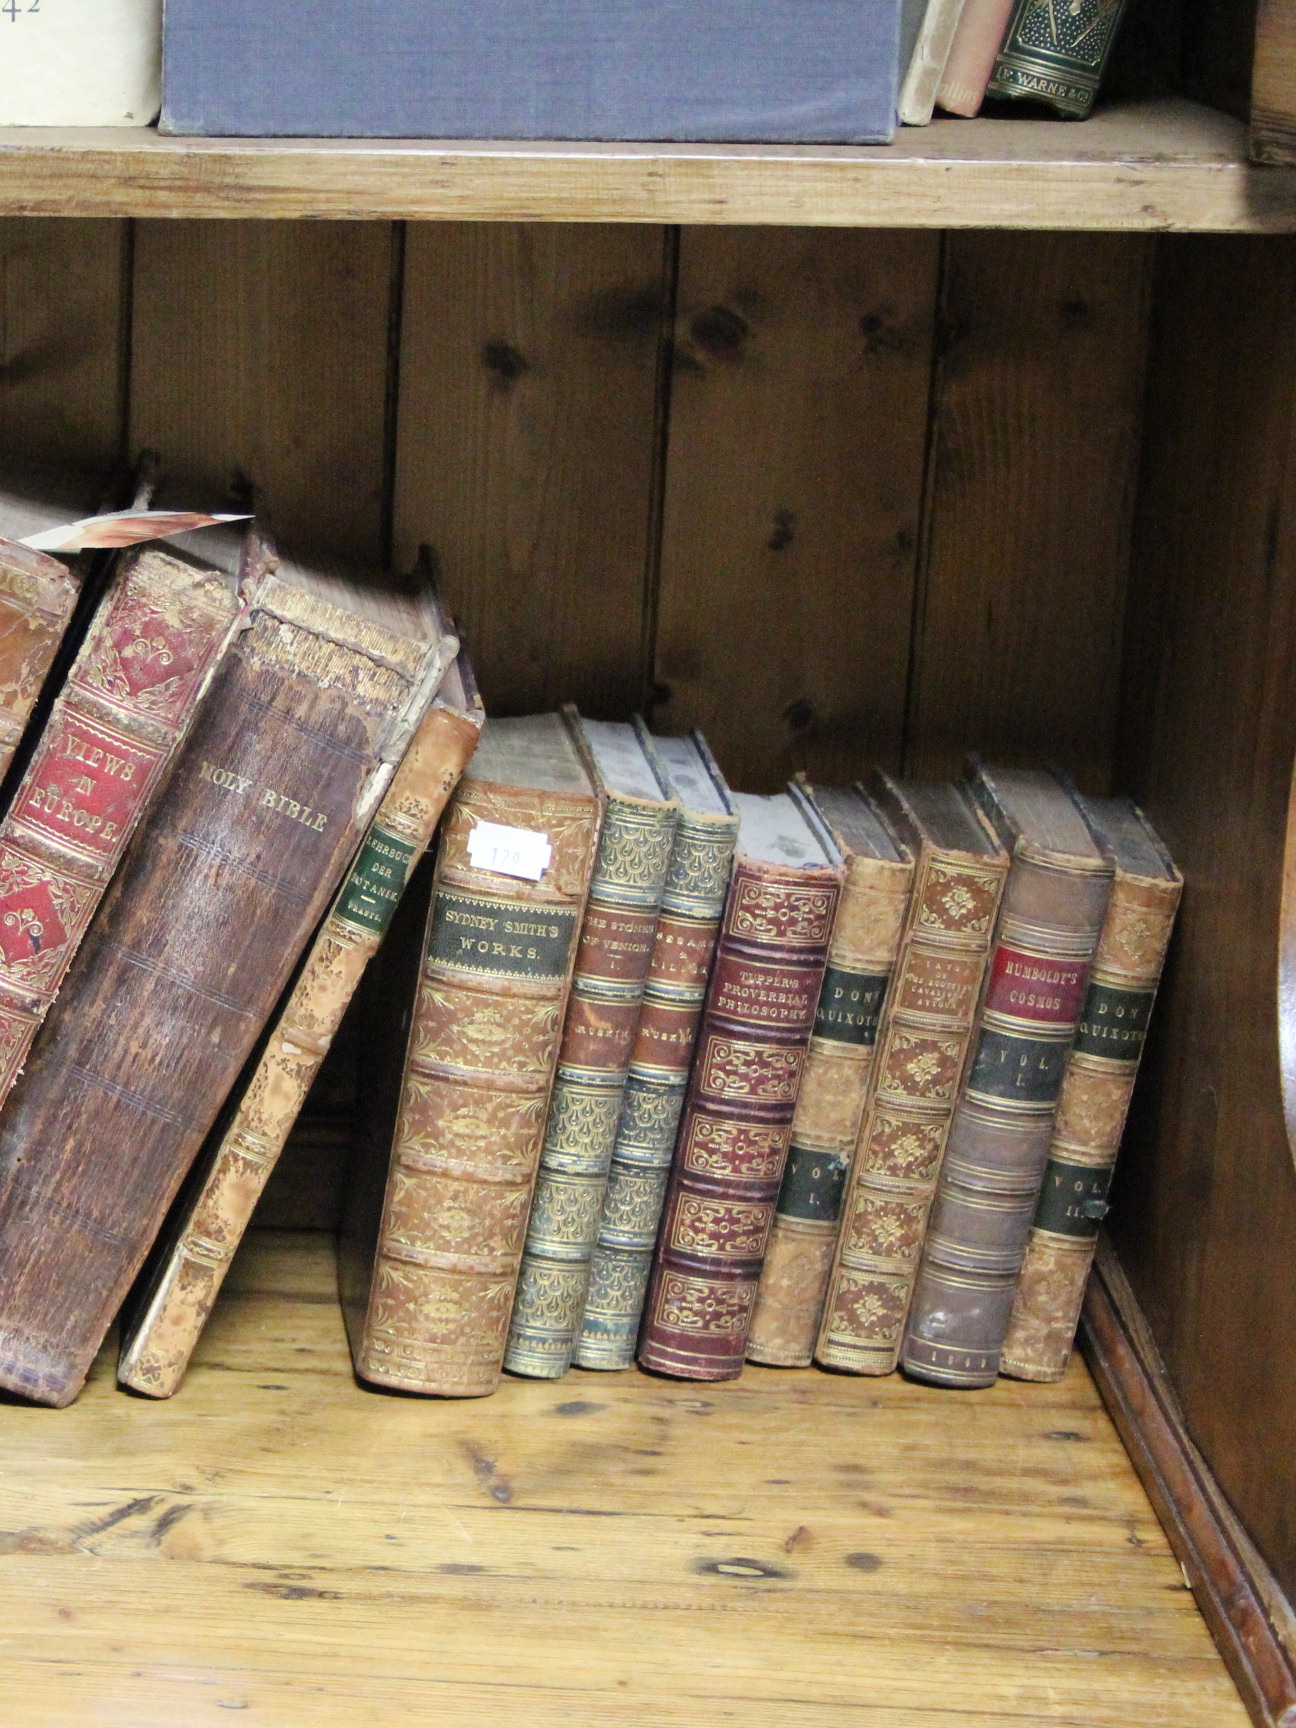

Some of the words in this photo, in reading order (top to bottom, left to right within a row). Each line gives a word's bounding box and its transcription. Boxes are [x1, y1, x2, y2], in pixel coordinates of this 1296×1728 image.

[941, 79, 979, 105] ollins
[1017, 71, 1067, 97] WARNE
[65, 734, 136, 781] VIEWS
[198, 761, 253, 795] HOLY
[261, 788, 328, 833] BIBLE
[29, 786, 118, 842] EUROPE.
[371, 862, 393, 878] DER
[445, 909, 498, 931] SYDNEY
[504, 920, 559, 938] SMITH'S
[459, 936, 540, 959] WORKS.
[679, 951, 688, 960] &
[1006, 961, 1078, 985] HUMBOLDT'S
[723, 982, 808, 1006] PROVERBIAL
[834, 987, 873, 1004] DON
[1010, 990, 1061, 1010] COSMOS
[718, 997, 807, 1020] PHILOSOPHY
[816, 1007, 880, 1027] QUIXOTE
[1098, 1003, 1138, 1020] DON
[1080, 1022, 1145, 1041] QUIXOTE
[1000, 1050, 1048, 1070] VOL.
[1055, 1176, 1101, 1194] VOL.
